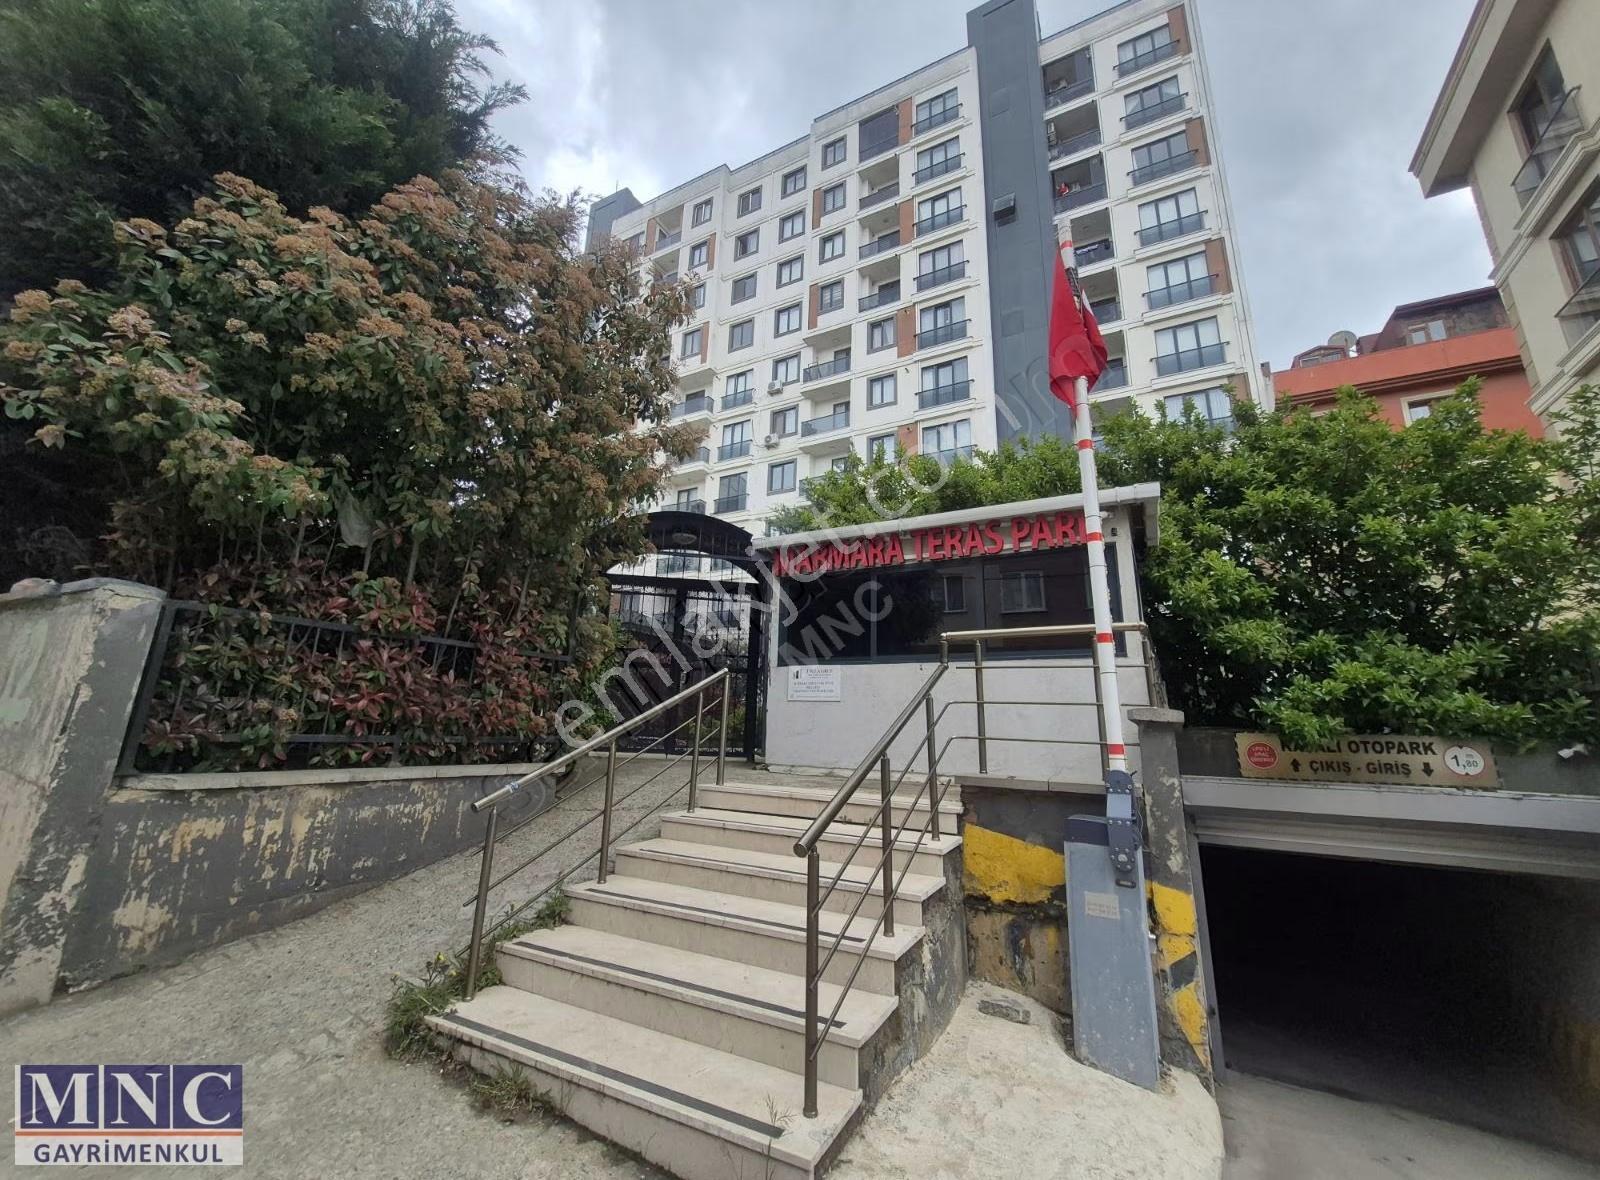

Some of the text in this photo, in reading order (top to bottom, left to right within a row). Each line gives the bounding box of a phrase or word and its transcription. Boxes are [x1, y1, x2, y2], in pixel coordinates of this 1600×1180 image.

[772, 533, 904, 576] MARMARA
[912, 521, 1004, 561] TERAS
[1347, 740, 1438, 756] OTOPARK
[1309, 760, 1352, 776] ÇIKIŞ
[1365, 759, 1413, 778] GİRİŞ
